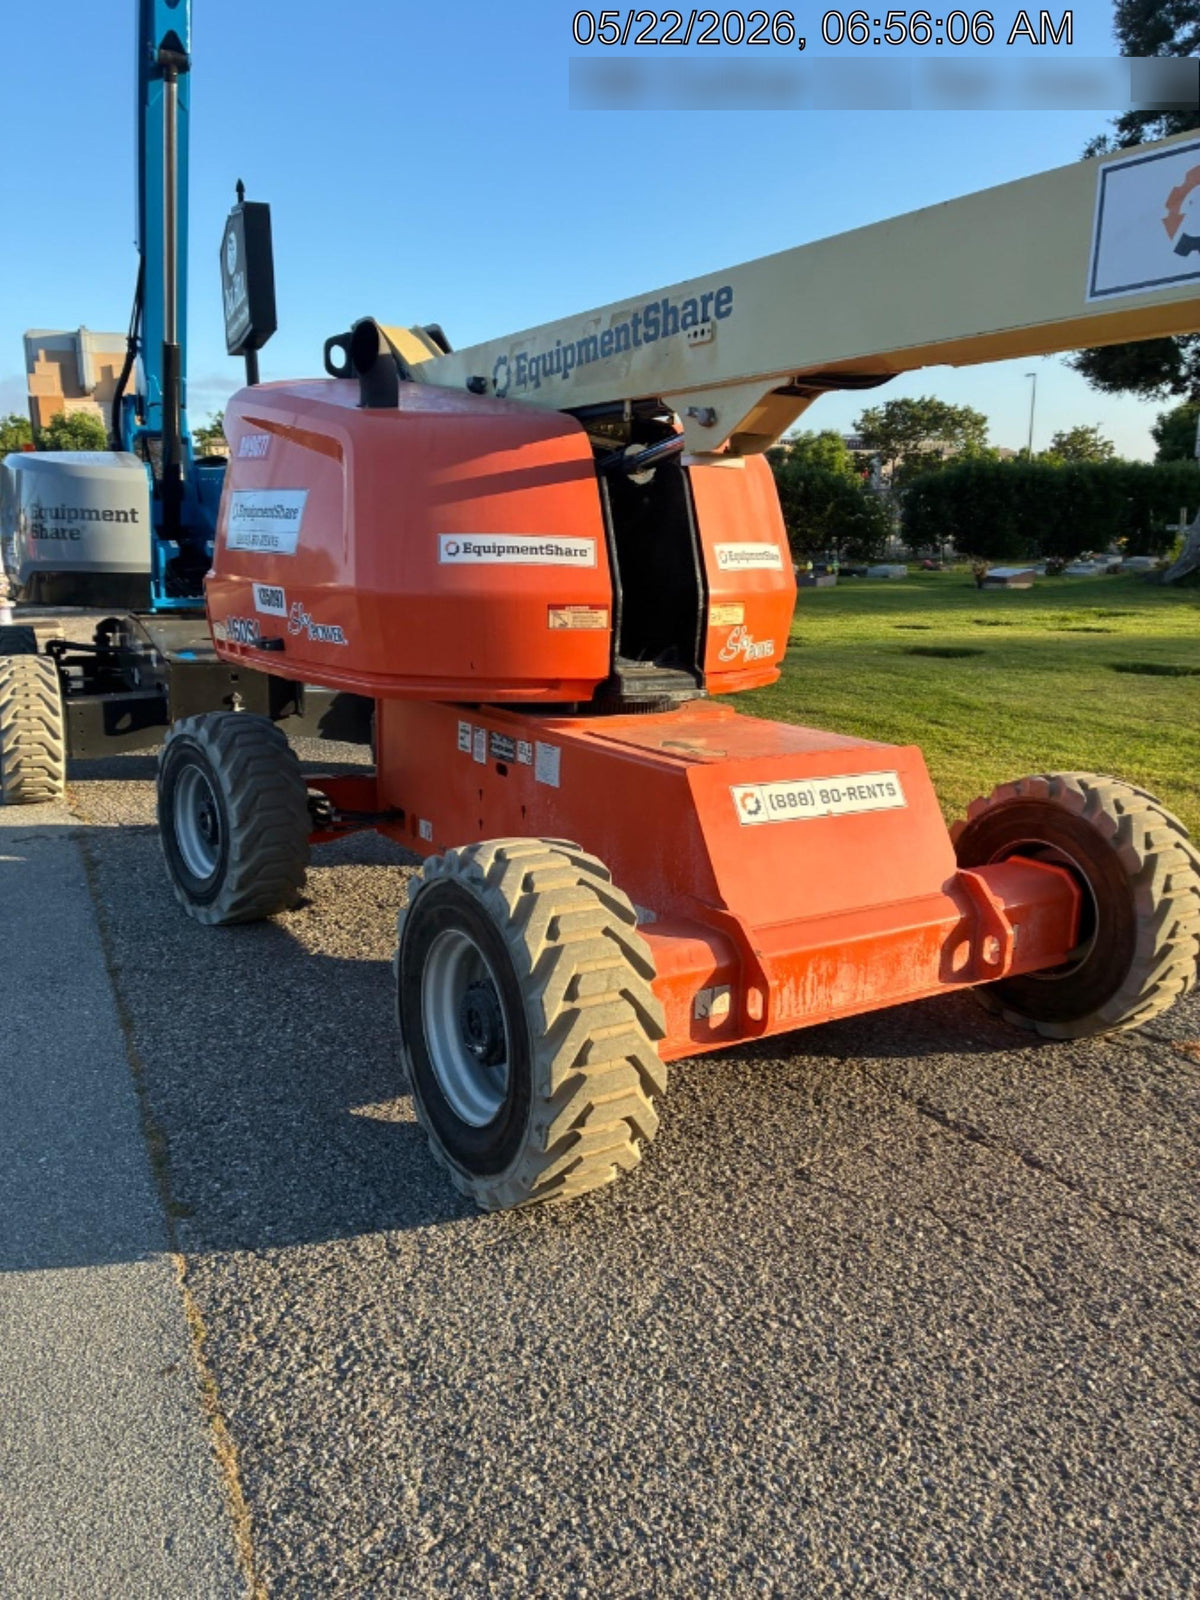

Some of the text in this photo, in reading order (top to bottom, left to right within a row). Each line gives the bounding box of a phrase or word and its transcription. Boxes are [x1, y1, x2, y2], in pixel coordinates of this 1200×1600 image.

[515, 285, 734, 389] EquipmentShare
[31, 503, 139, 524] Equipment
[31, 524, 81, 541] Share
[462, 541, 588, 558] EquipmentShare
[768, 782, 897, 811] (888) 80-RENTS
